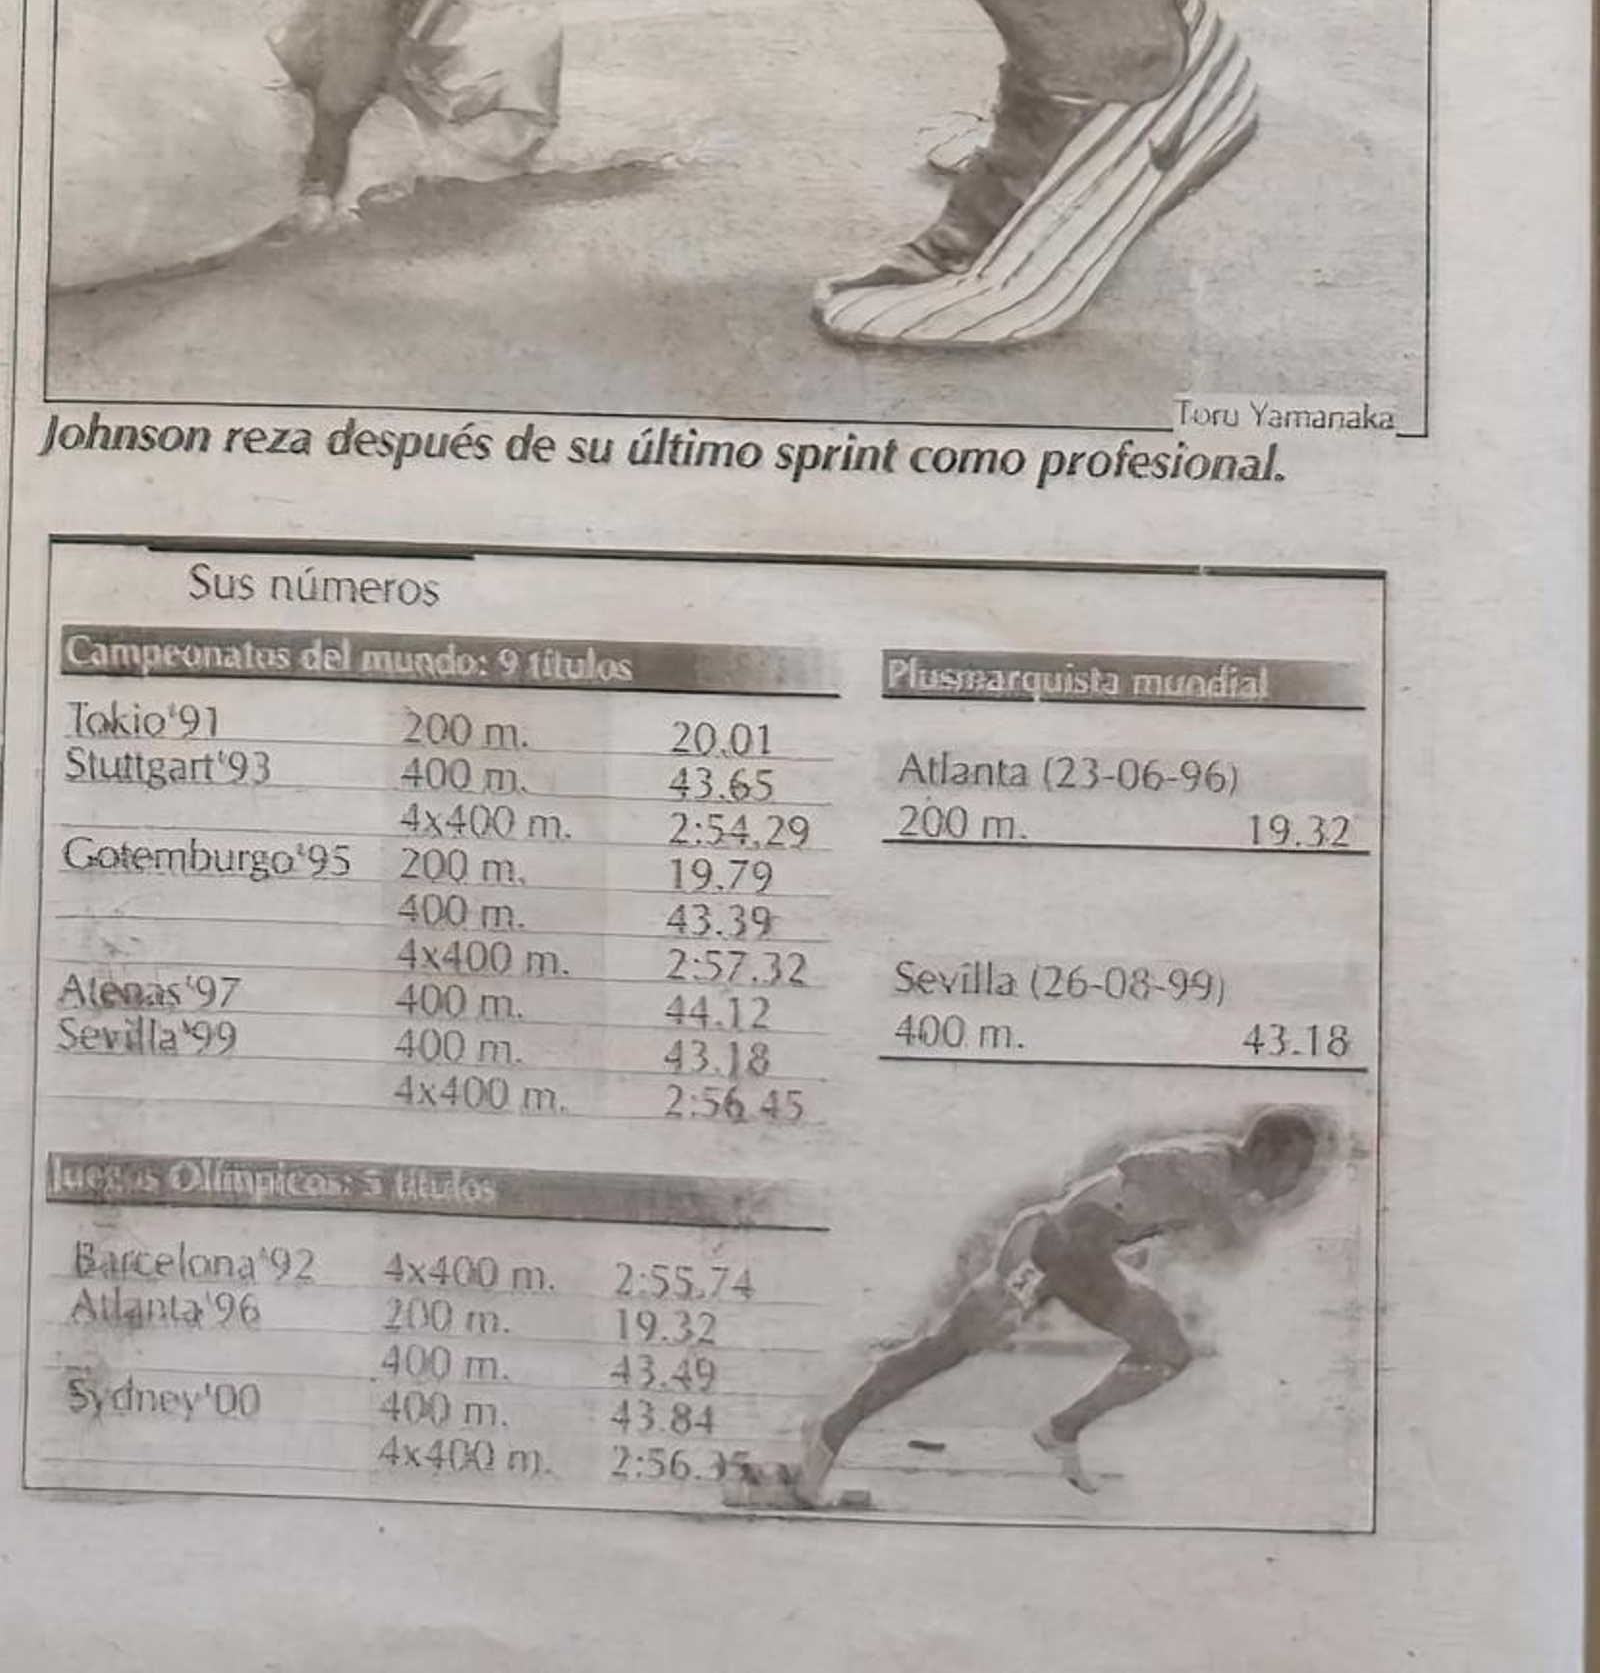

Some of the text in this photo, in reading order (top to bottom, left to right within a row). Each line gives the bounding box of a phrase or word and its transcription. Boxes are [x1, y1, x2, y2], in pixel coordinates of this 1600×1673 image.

[1174, 400, 1395, 430] Toru Yamanaka
[38, 412, 1285, 490] Johnson reza después de su último sprint como profesional.
[190, 563, 439, 607] Sus números
[64, 634, 633, 681] Campeonatos del mundo: 9 títulos
[1132, 667, 1269, 699] mundial
[403, 711, 528, 751] 200 m.
[671, 722, 776, 759] 20.01
[401, 757, 528, 795] 400 m.
[669, 767, 773, 804] 43.65
[898, 751, 1238, 796] Atlanta (23-06-96)
[400, 803, 571, 842] 4x400 m.
[669, 812, 809, 850] 2:54.29
[900, 806, 1027, 839] 200 m.
[1251, 815, 1349, 847] 19.32
[670, 858, 773, 896] 19.79
[667, 904, 776, 941] 43.39
[667, 948, 809, 988] 2:57.32
[895, 960, 1225, 1007] Sevilla (26-08-99)
[665, 995, 769, 1033] 44.12
[895, 1014, 1024, 1049] 400 m.
[1243, 1024, 1350, 1058] 43.18
